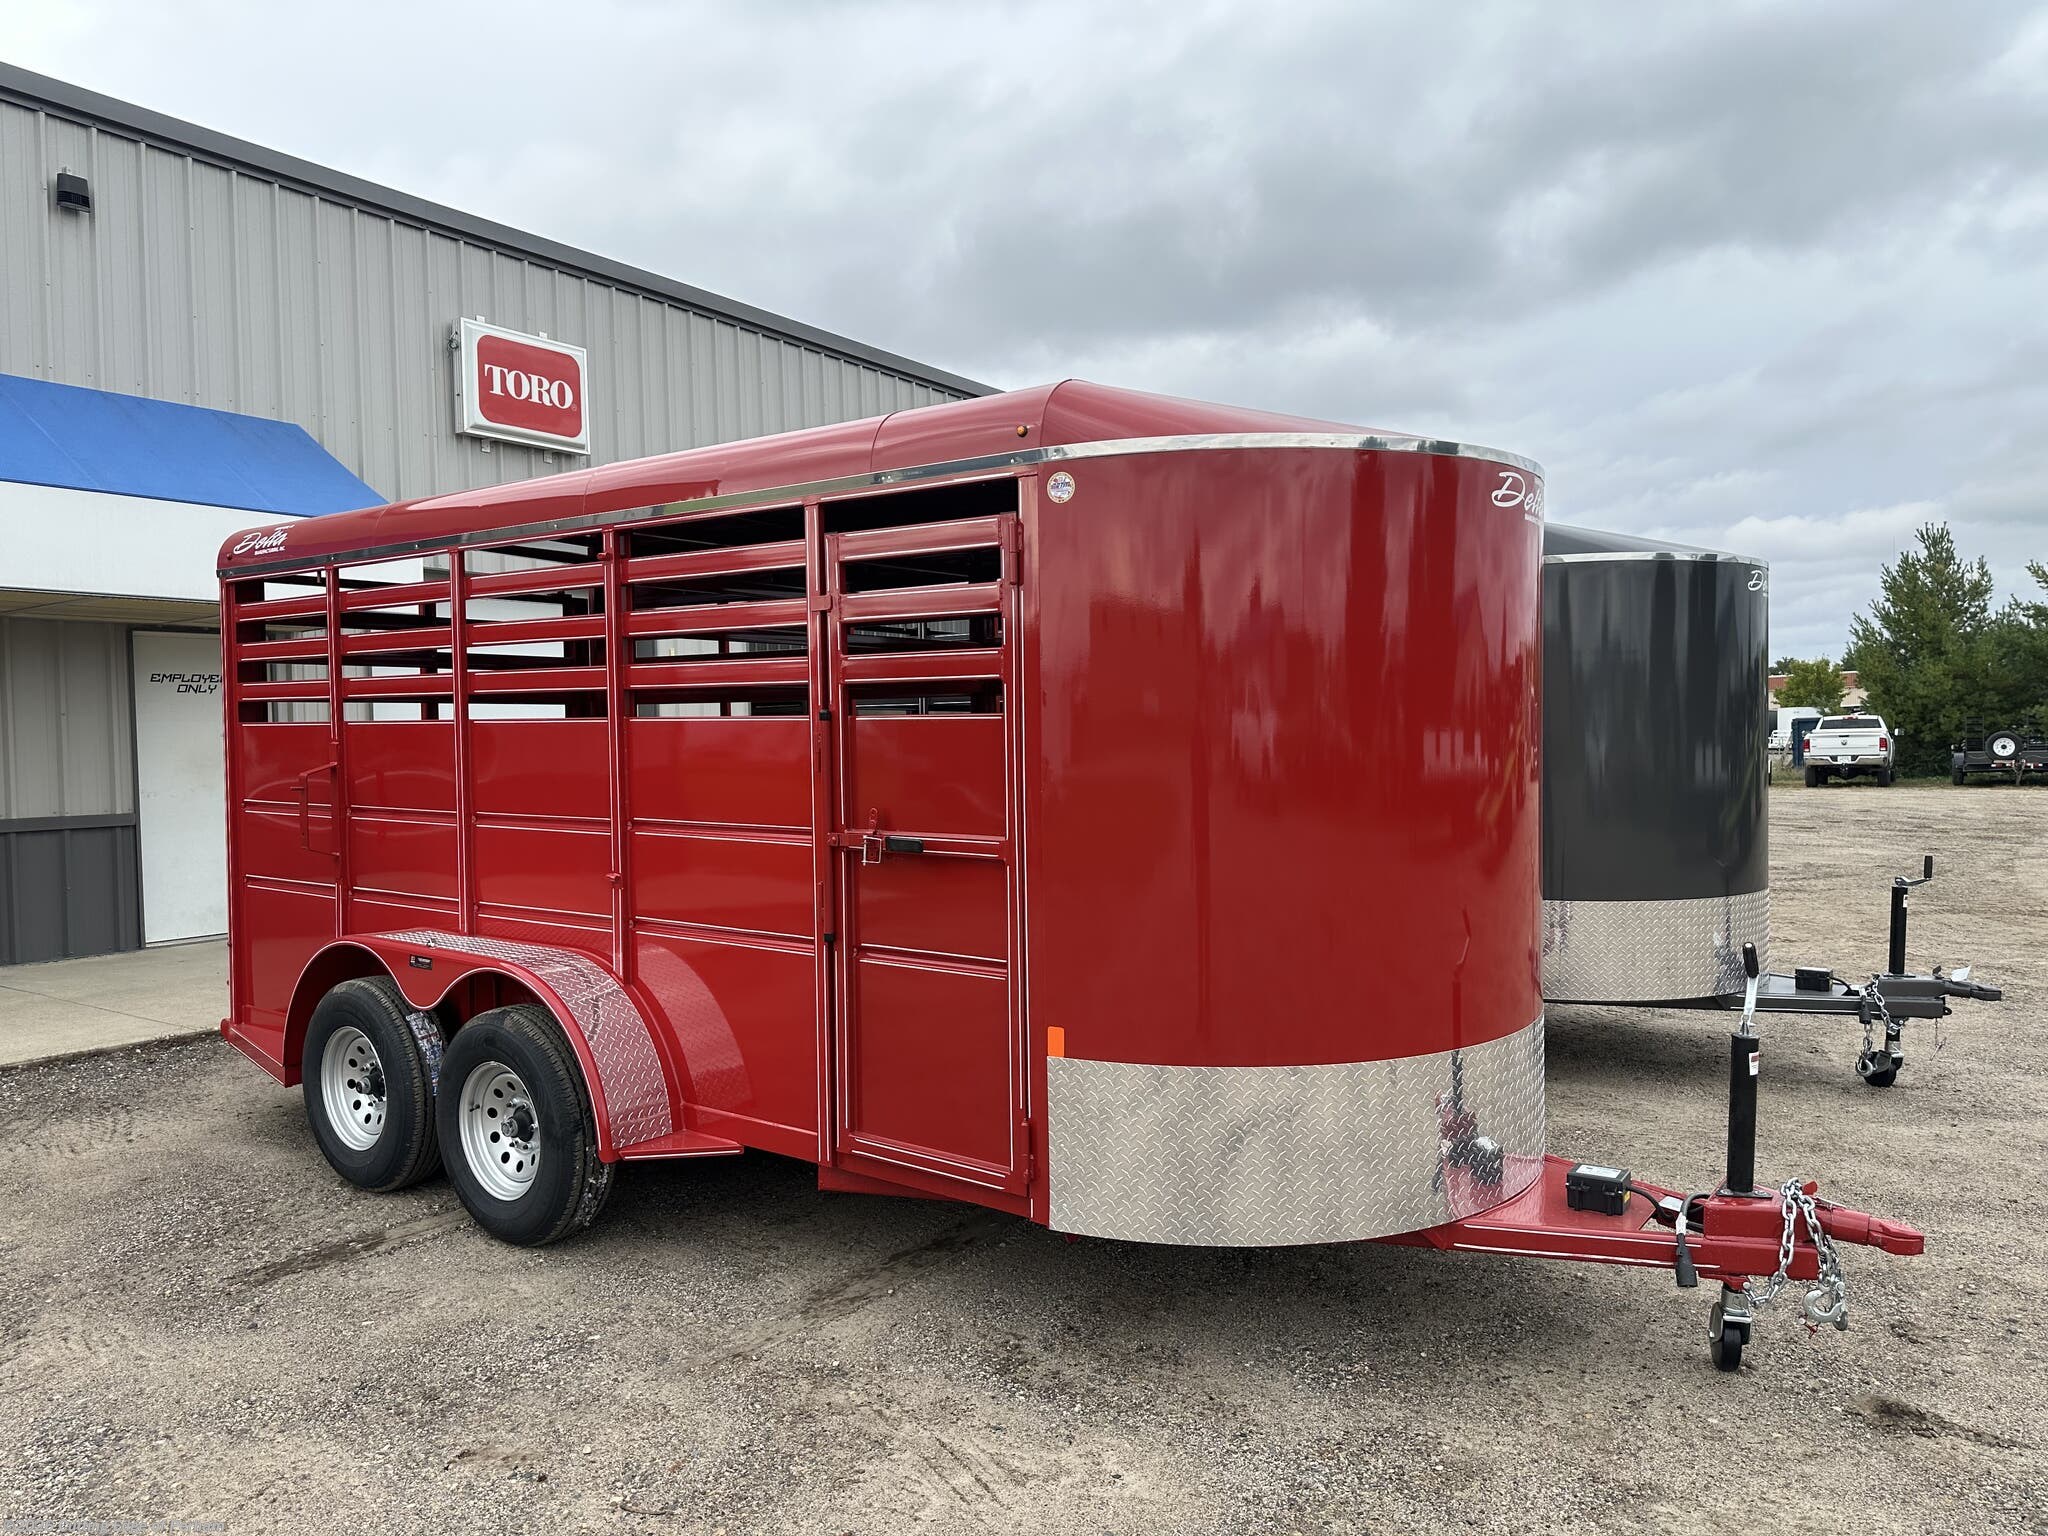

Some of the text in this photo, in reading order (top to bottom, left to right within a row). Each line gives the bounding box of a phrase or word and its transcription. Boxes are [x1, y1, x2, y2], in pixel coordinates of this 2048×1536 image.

[484, 364, 574, 410] TORO
[150, 673, 222, 684] EMPLOYE
[176, 684, 218, 695] ONLY
